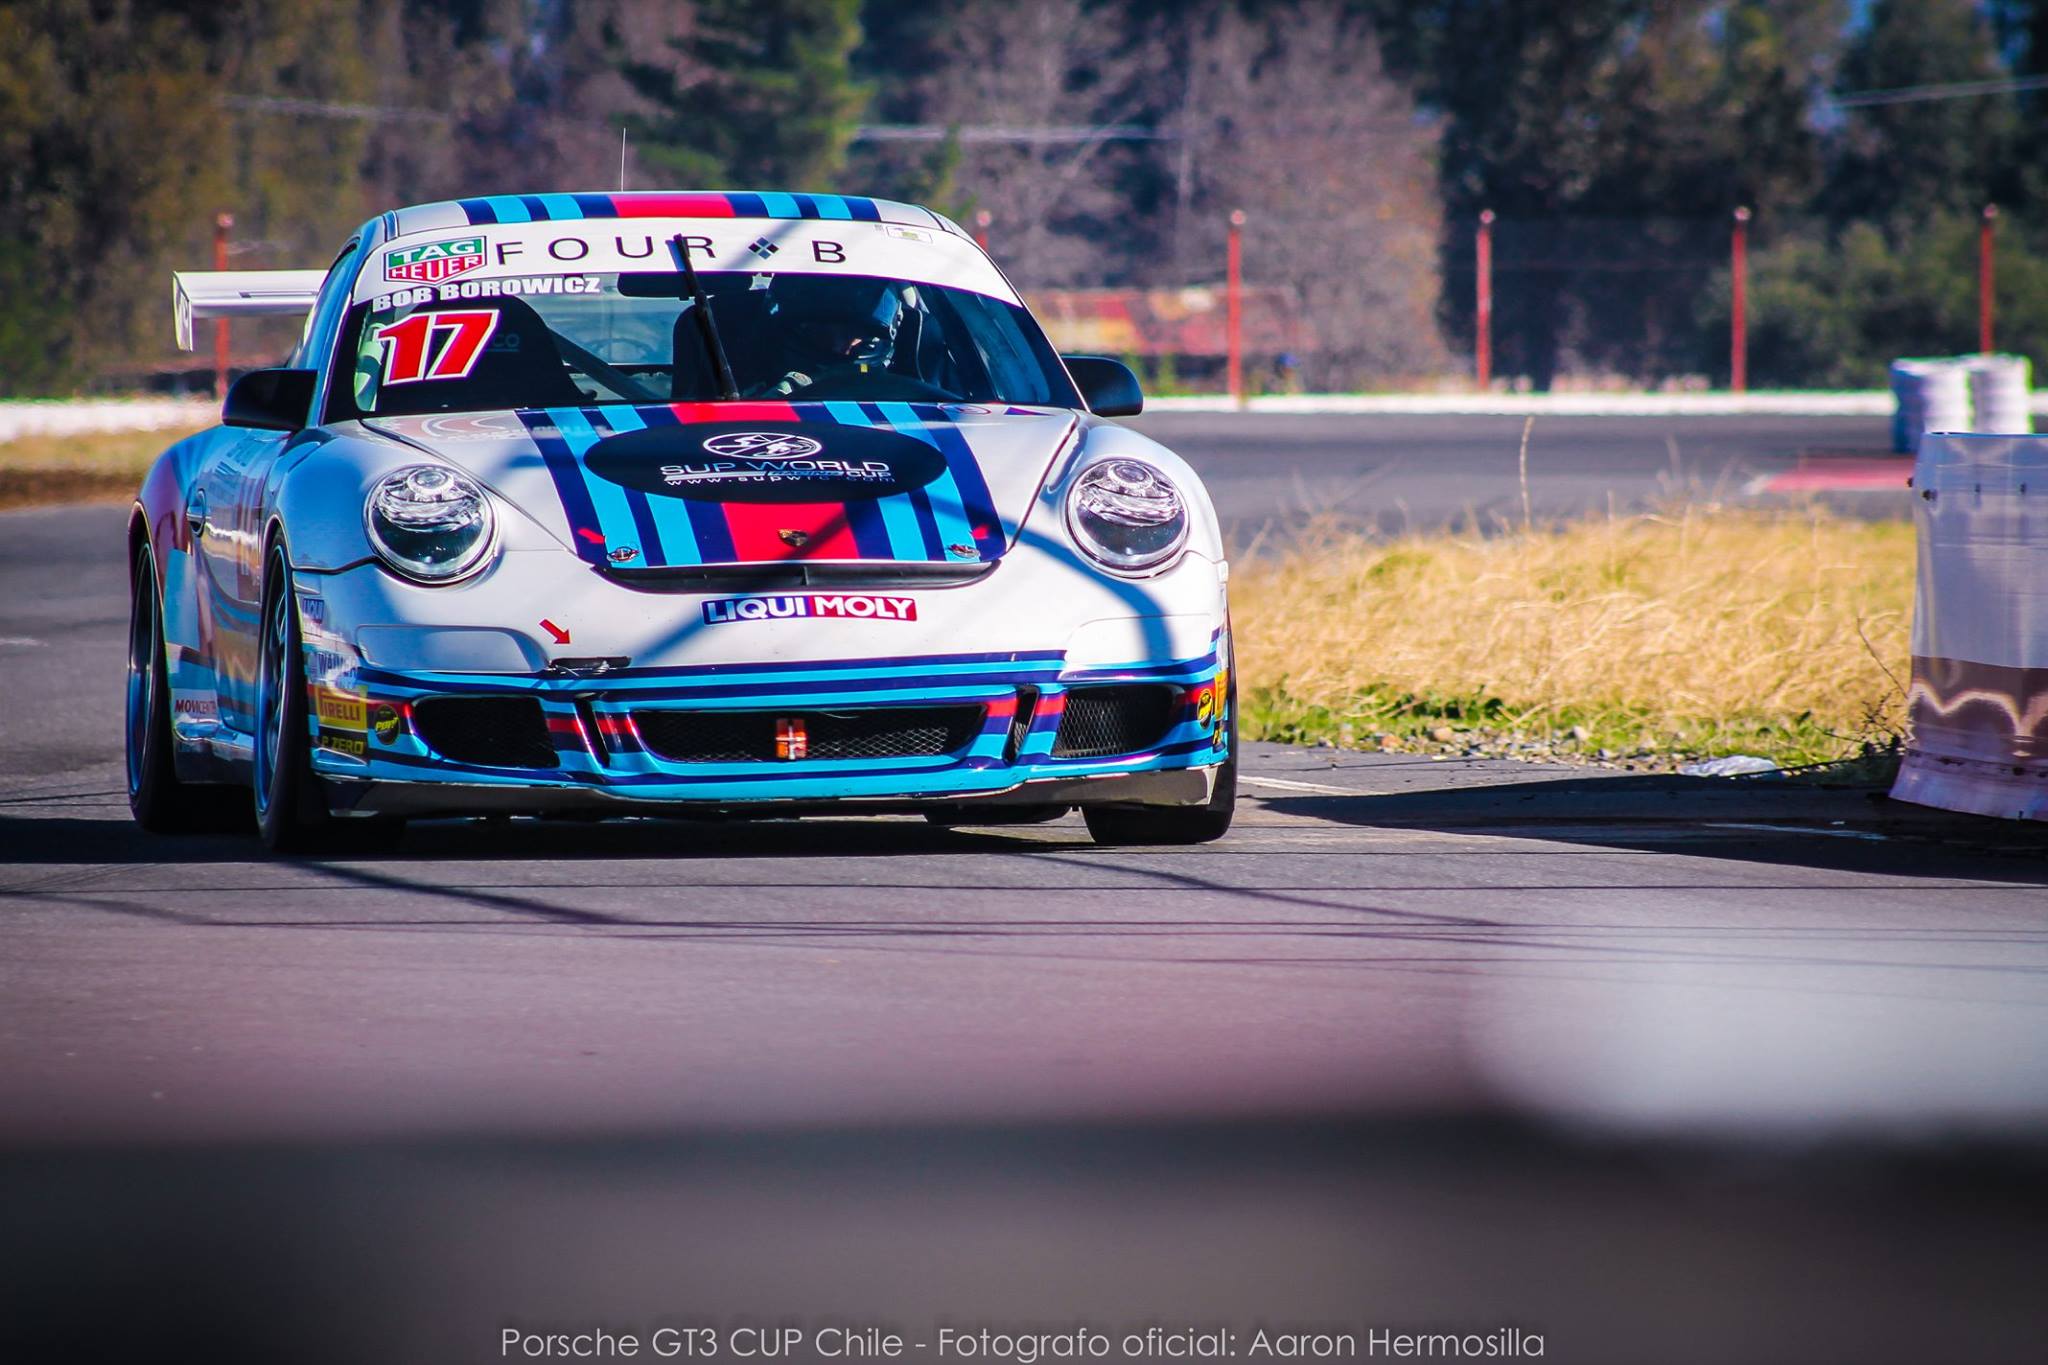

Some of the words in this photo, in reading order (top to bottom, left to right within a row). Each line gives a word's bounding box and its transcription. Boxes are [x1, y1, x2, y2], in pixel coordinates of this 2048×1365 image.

[393, 241, 476, 267] TAG
[496, 235, 716, 265] FOUR
[811, 240, 847, 263] B
[391, 256, 481, 279] HEUER
[372, 286, 433, 312] BOB
[440, 277, 600, 300] BOROWICZ
[376, 309, 500, 386] 17
[660, 461, 737, 476] SUP
[746, 460, 890, 474] WORLD
[707, 596, 806, 623] LIQUI
[814, 596, 917, 620] MOLY
